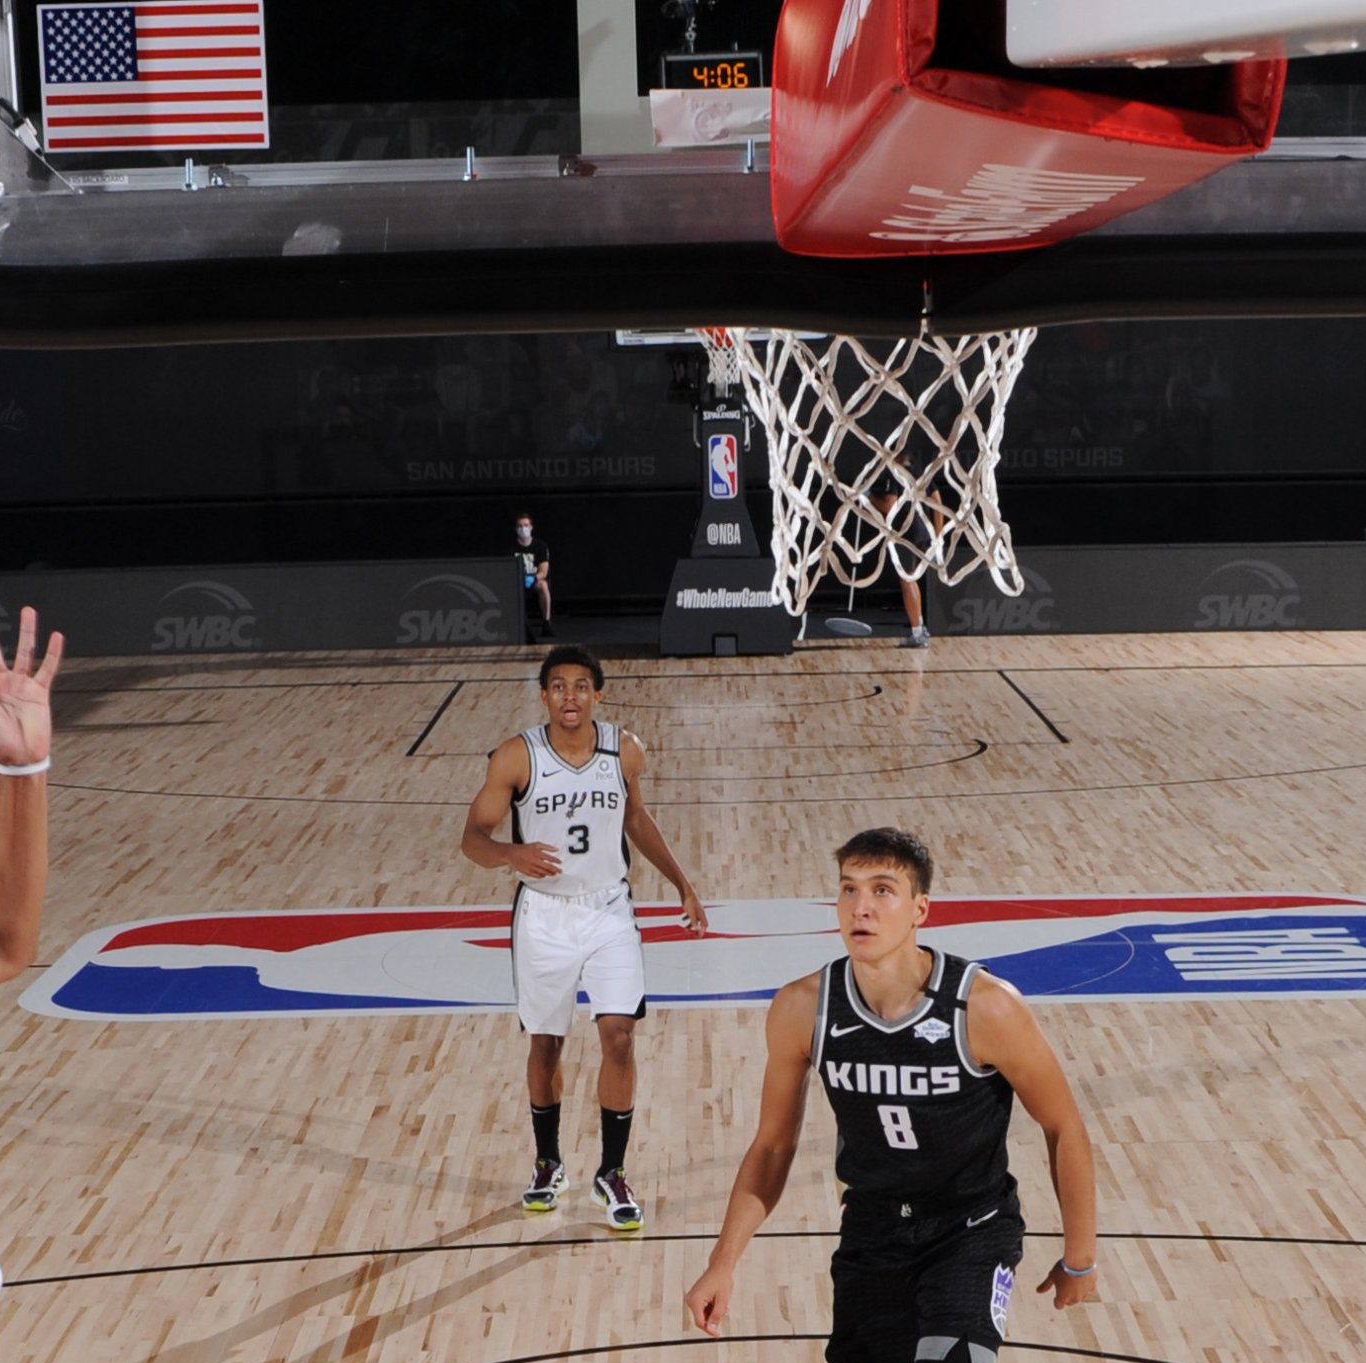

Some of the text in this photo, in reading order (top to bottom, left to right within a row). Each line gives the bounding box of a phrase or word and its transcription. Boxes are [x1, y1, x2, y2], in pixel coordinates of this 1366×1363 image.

[693, 62, 749, 89] 4:06
[407, 456, 656, 481] SAN ANTONIO SPURS
[1043, 447, 1125, 468] SPURS
[707, 523, 741, 546] @NBA
[948, 598, 1056, 631] SWBC
[1195, 594, 1301, 627] SWBC
[152, 616, 257, 650] SWBC
[396, 609, 501, 644] SWBC
[535, 791, 619, 819] SPURS
[568, 824, 589, 854] 3
[826, 1060, 960, 1096] KINGS
[877, 1105, 919, 1150] 8
